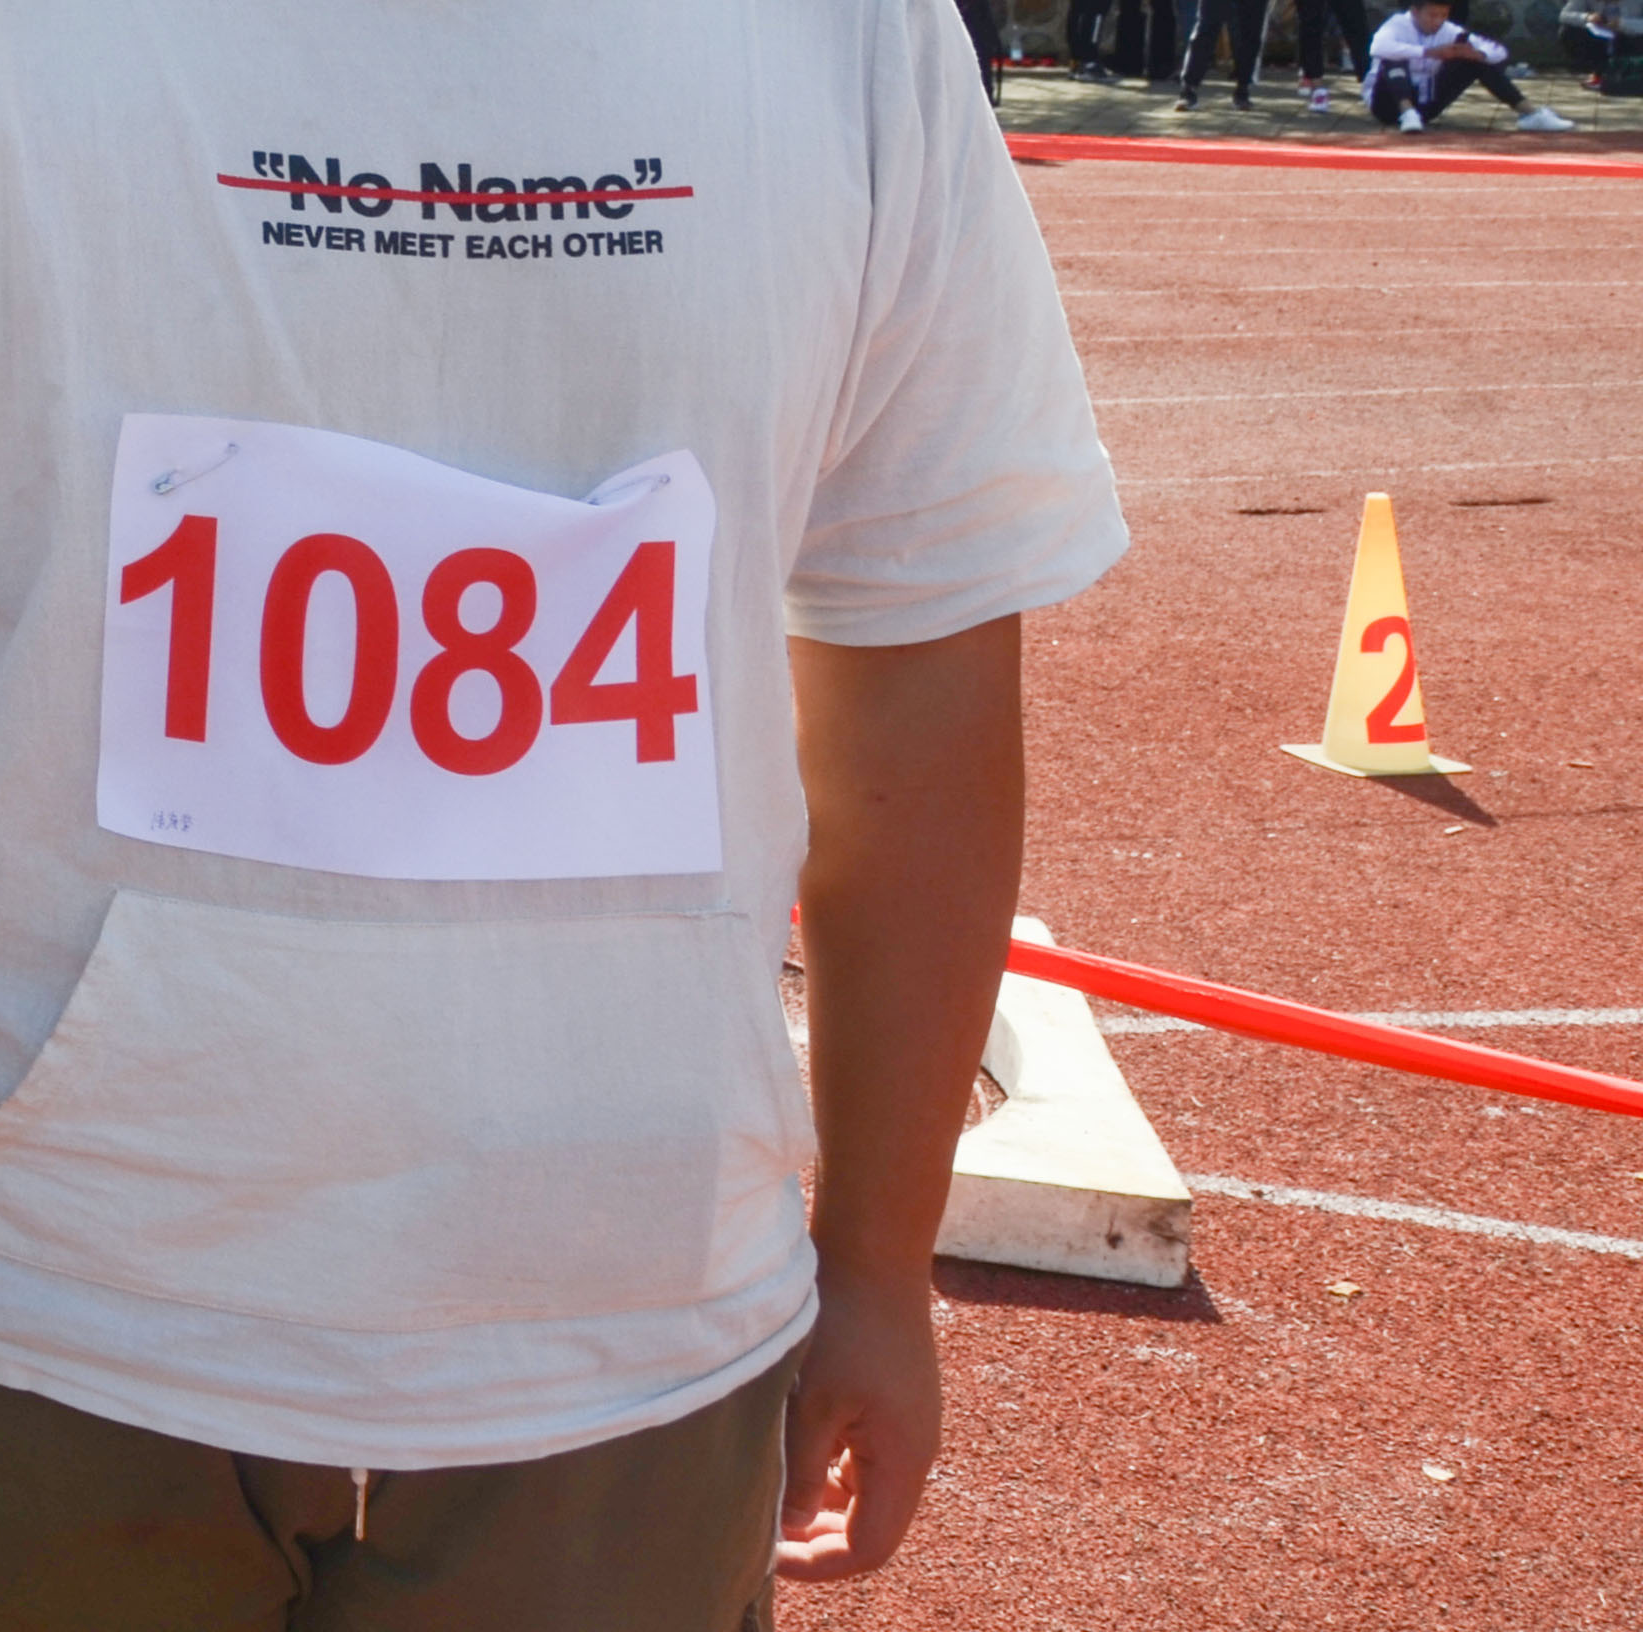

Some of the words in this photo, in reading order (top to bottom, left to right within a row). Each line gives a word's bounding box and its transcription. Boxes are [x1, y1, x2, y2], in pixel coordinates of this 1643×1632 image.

[263, 221, 366, 252] NEVER
[375, 230, 455, 258] MEET
[466, 232, 553, 259] EACH
[563, 230, 664, 256] OTHER
[119, 514, 698, 777] 1084
[1360, 615, 1426, 745] 2
